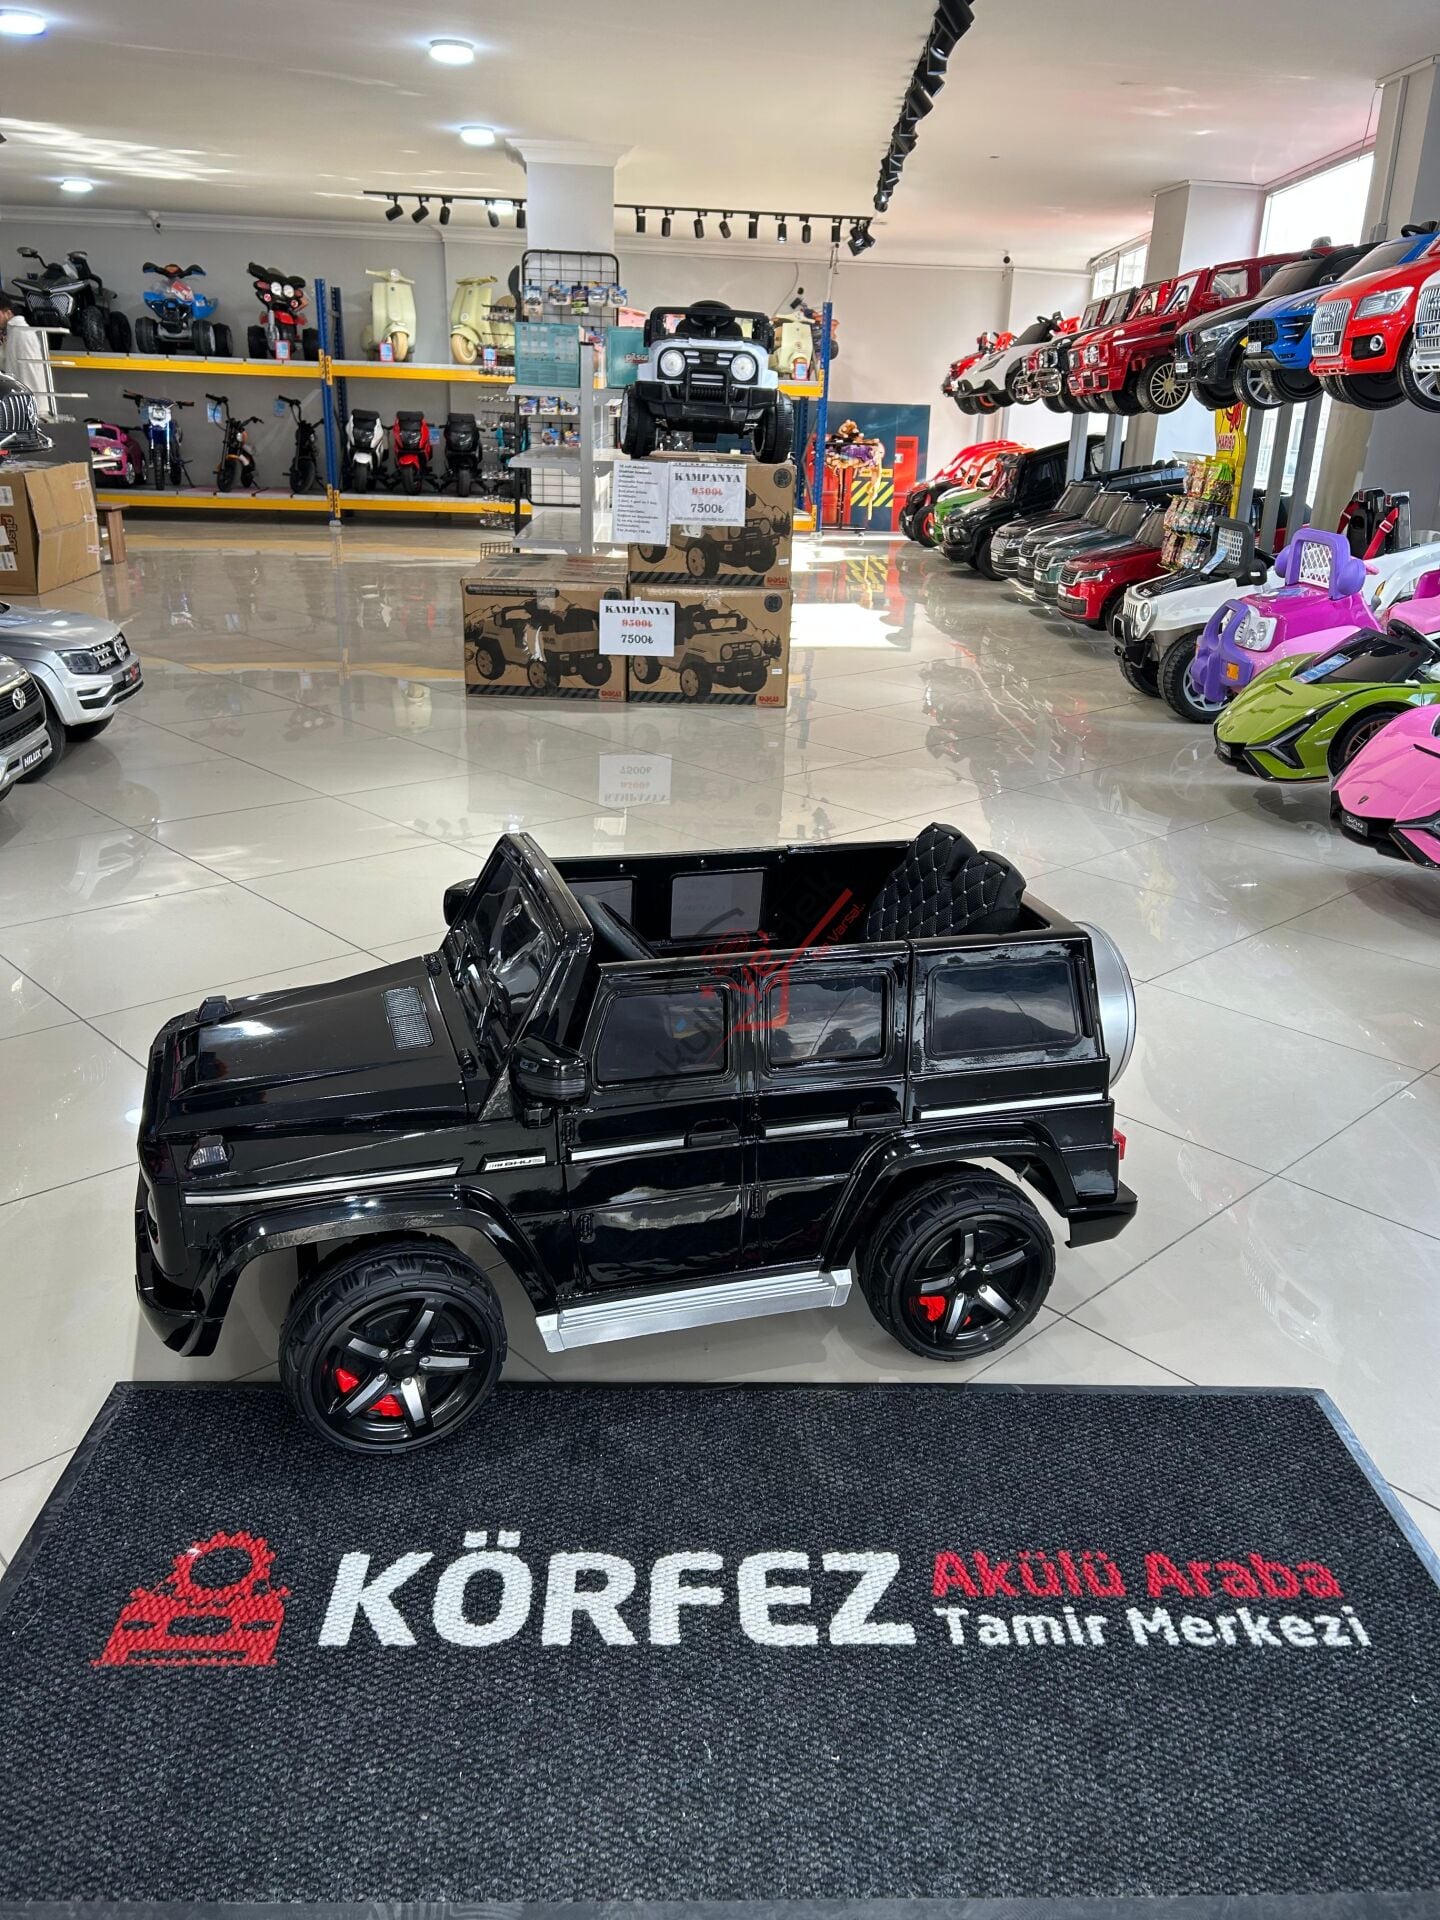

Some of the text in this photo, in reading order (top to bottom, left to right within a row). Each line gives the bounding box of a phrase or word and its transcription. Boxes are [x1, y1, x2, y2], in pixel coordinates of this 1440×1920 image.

[674, 472, 741, 483] KAMPANYA
[690, 503, 724, 514] 7500₺
[605, 605, 670, 616] KAMPANYA
[621, 634, 654, 644] 7500₺
[24, 748, 42, 767] HILUX
[318, 1530, 1344, 1648] KÖRFEZ Akülü Araba
[934, 1605, 1371, 1647] Tamir Merkezi
